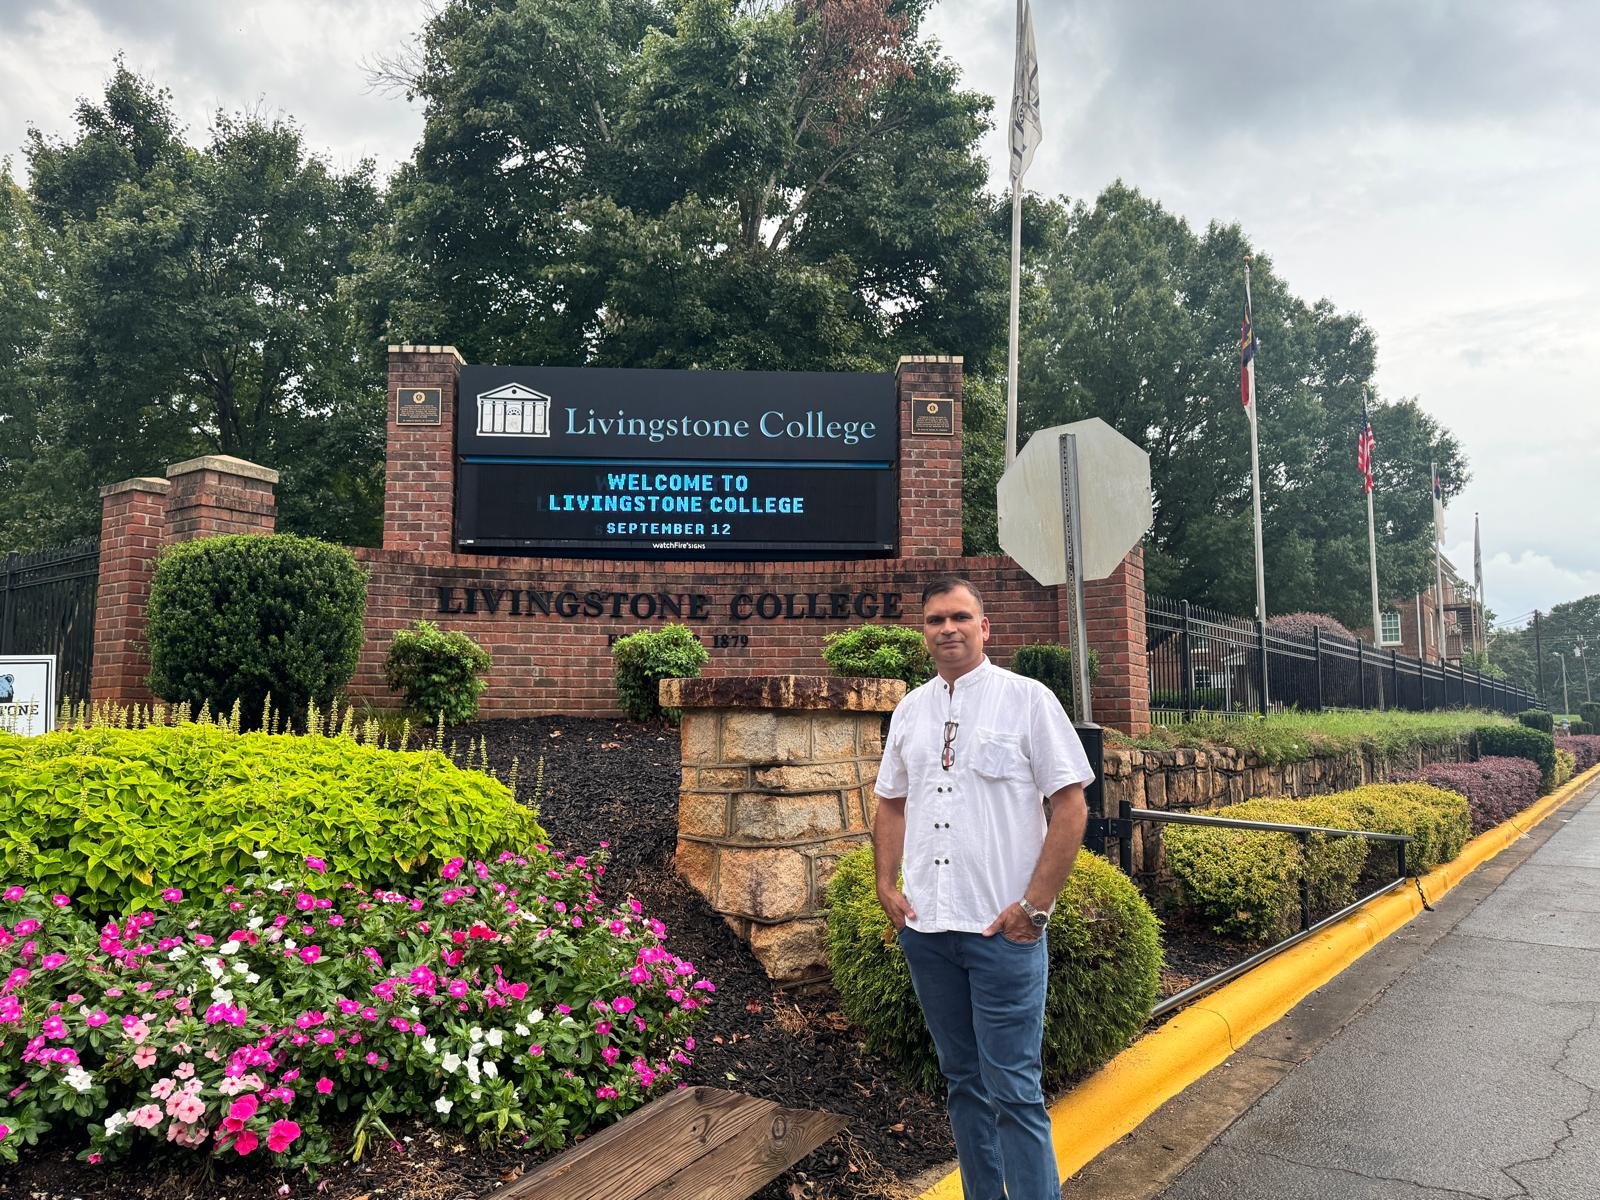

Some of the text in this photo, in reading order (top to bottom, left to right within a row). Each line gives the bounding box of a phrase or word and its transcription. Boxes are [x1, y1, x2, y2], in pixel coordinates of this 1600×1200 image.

[564, 407, 750, 442] Livingstone
[759, 410, 876, 445] College
[607, 473, 748, 492] WELCOME TO
[549, 494, 804, 514] LIVINGSTONE COLLEGE
[606, 522, 731, 535] SEPTEMBER 12
[437, 586, 905, 620] LIVINGSTONE COLLEGE
[713, 634, 749, 649] 1879
